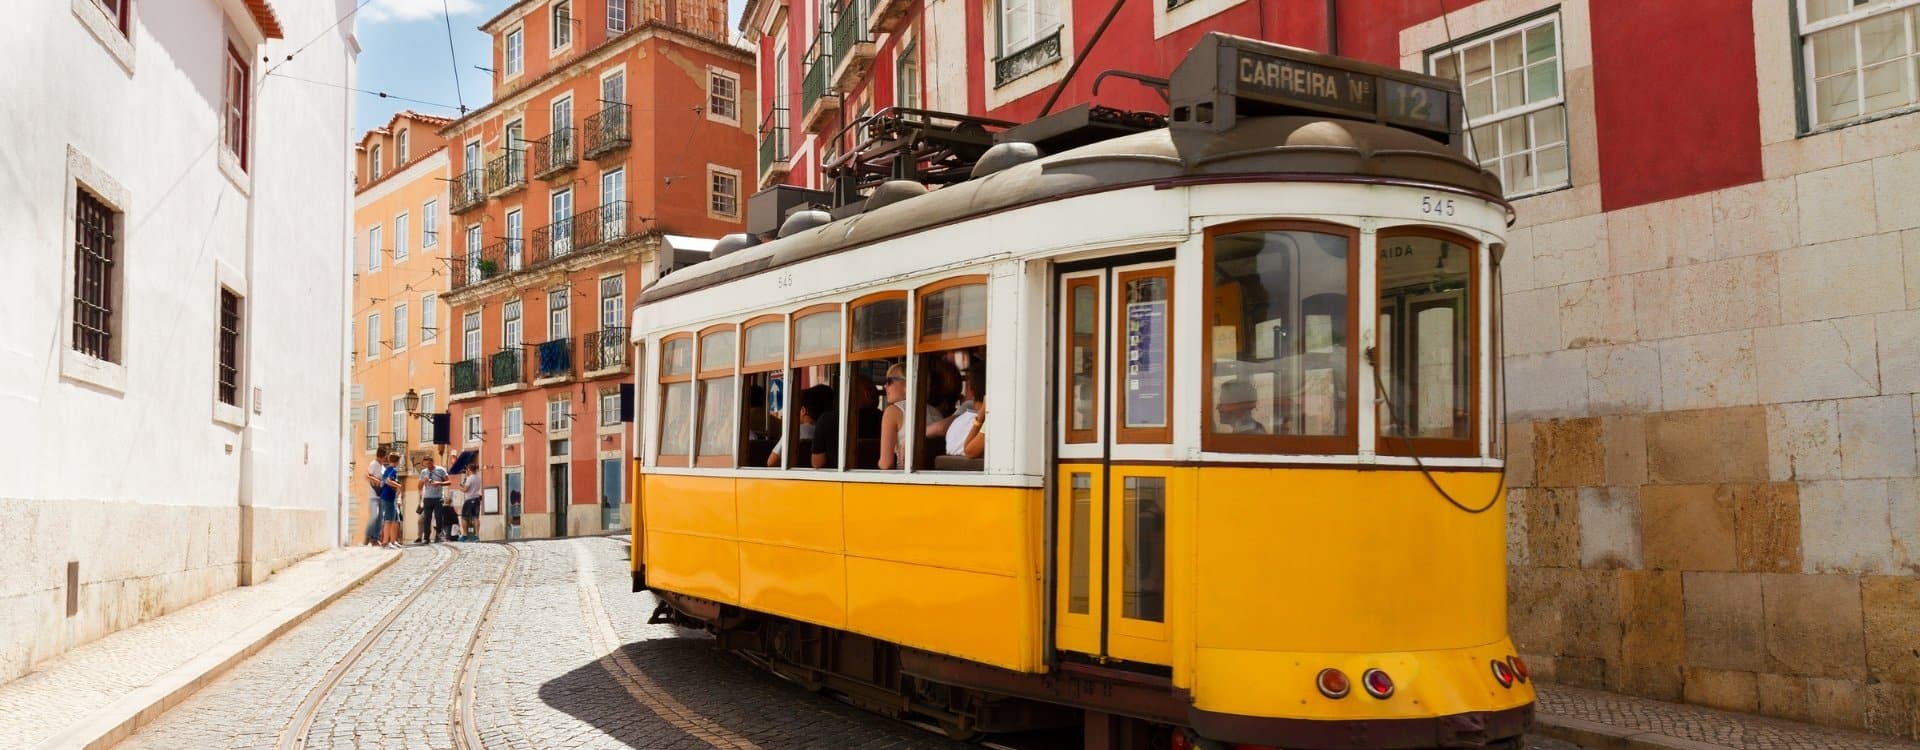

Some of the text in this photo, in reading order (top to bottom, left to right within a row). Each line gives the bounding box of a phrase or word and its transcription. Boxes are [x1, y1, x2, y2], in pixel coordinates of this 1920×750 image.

[1239, 58, 1339, 100] CARREIRA
[1396, 85, 1429, 119] 12
[1422, 196, 1455, 217] 545
[777, 271, 793, 288] 545
